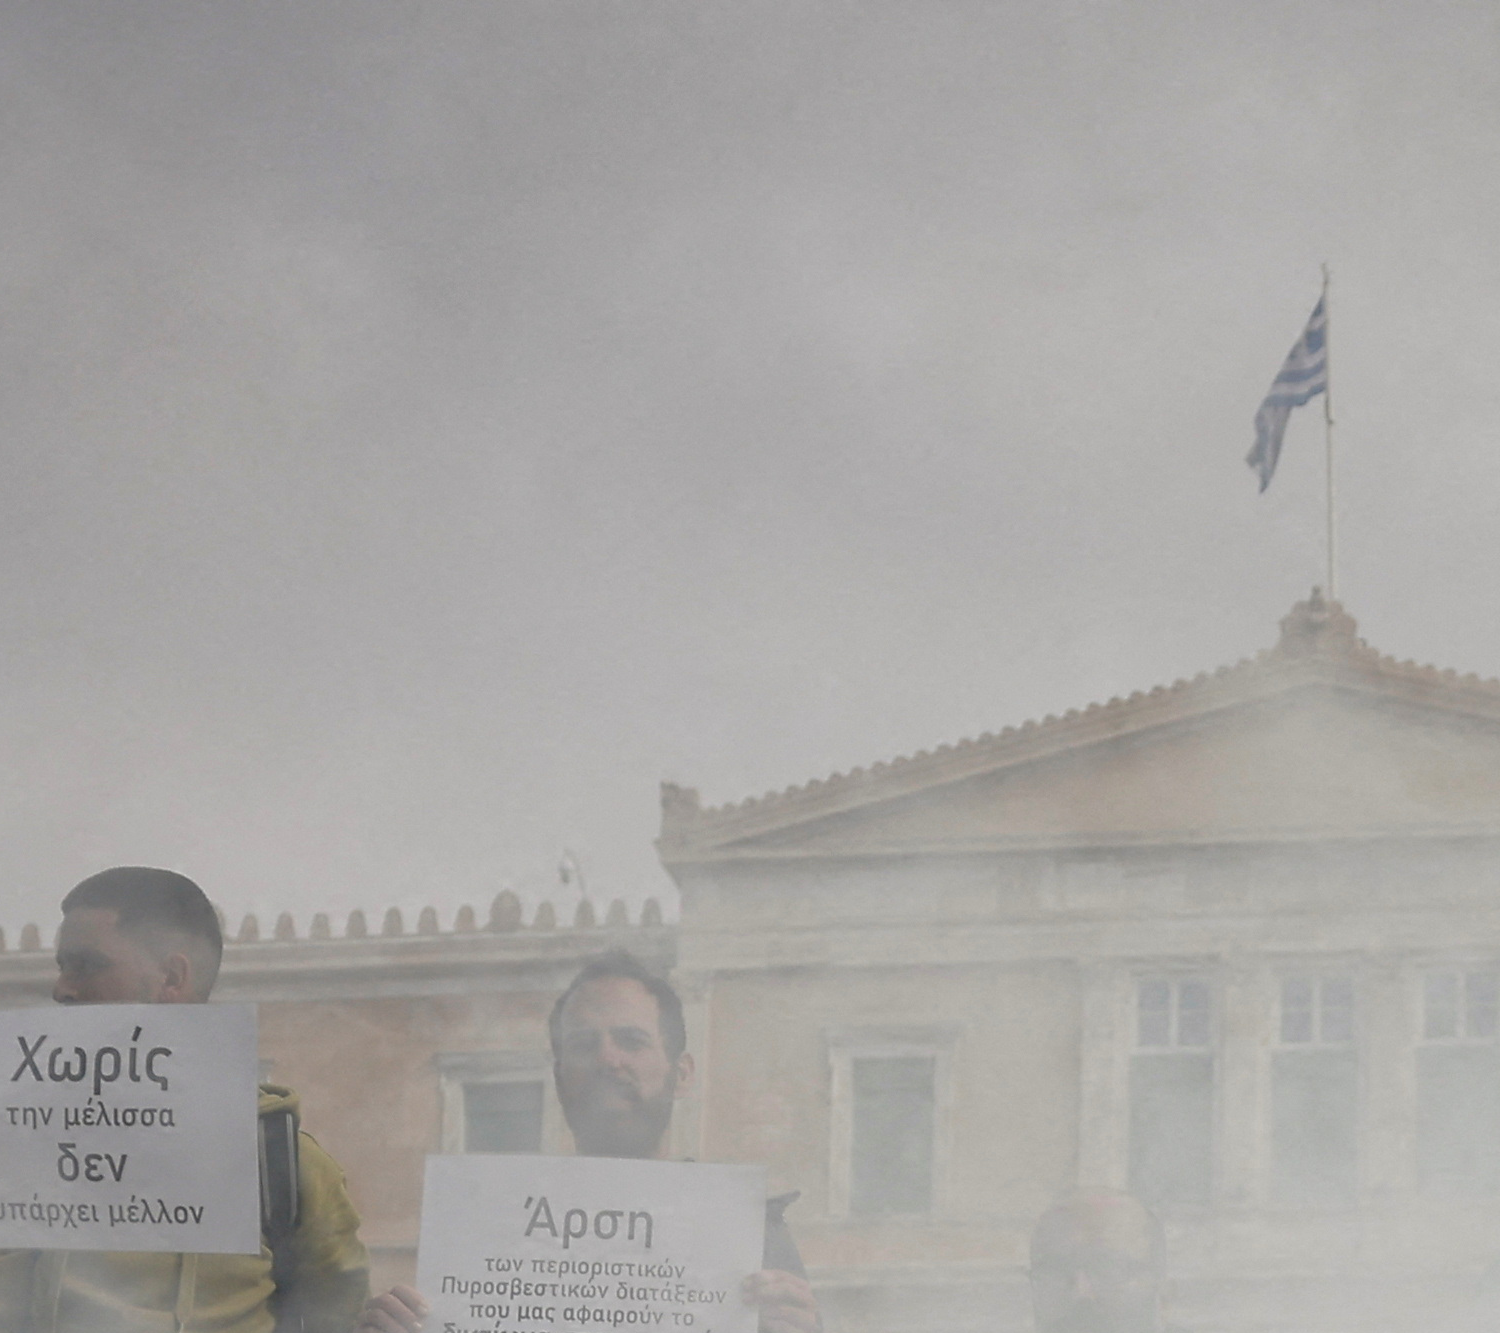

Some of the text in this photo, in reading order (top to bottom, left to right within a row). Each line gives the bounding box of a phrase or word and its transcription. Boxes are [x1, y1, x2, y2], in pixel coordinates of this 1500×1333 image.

[9, 1026, 174, 1096] Χωρίς
[5, 1098, 177, 1132] την μέλισσα
[56, 1141, 129, 1185] δεν
[108, 1193, 205, 1229] μέλλον
[522, 1195, 656, 1250] Άρση
[483, 1253, 687, 1283] των περιοριστικών
[440, 1275, 728, 1308] Πυροσβεστικών διατάξεων
[468, 1302, 696, 1329] που μας αφαιρούν το
